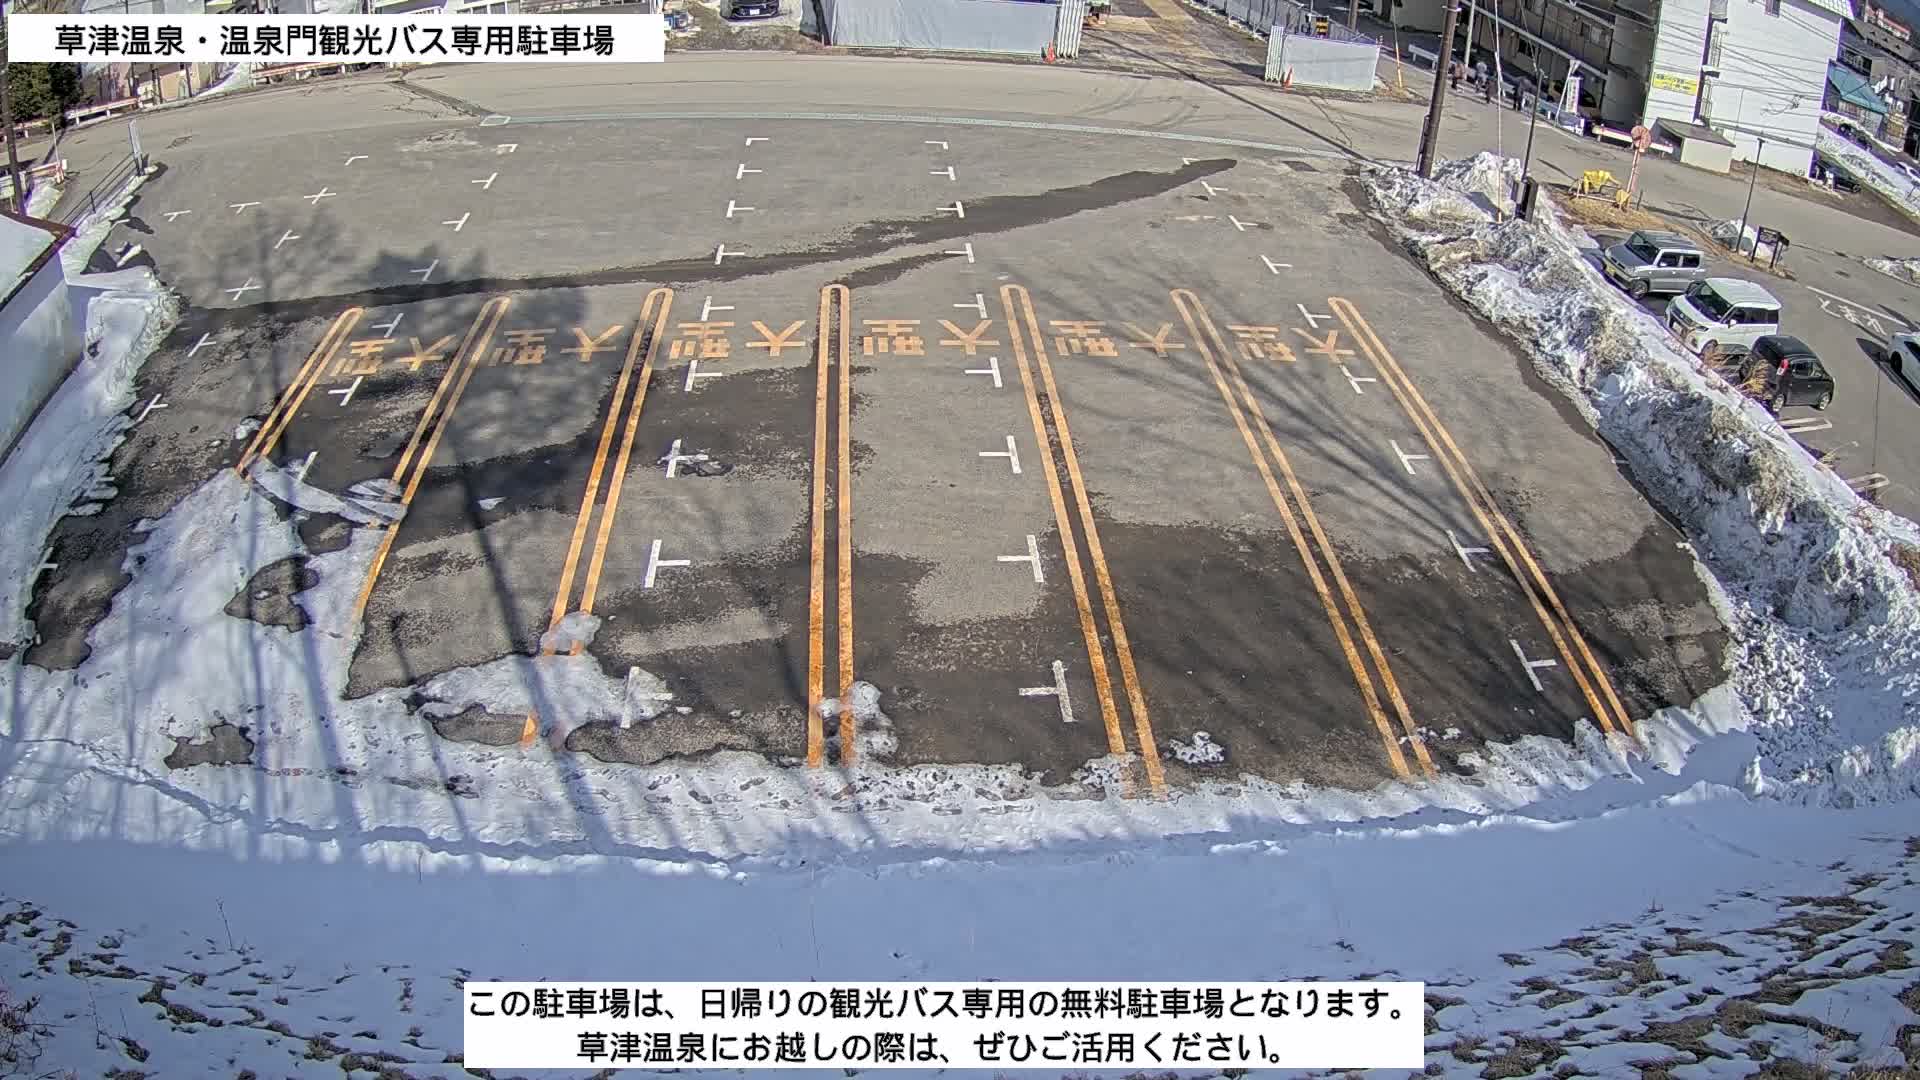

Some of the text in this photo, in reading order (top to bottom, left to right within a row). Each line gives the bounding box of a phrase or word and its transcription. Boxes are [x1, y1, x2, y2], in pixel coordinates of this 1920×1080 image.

[669, 320, 808, 361] 大型
[862, 319, 1001, 356] 大型
[1048, 319, 1187, 359] 大型
[1225, 325, 1356, 363] 大型
